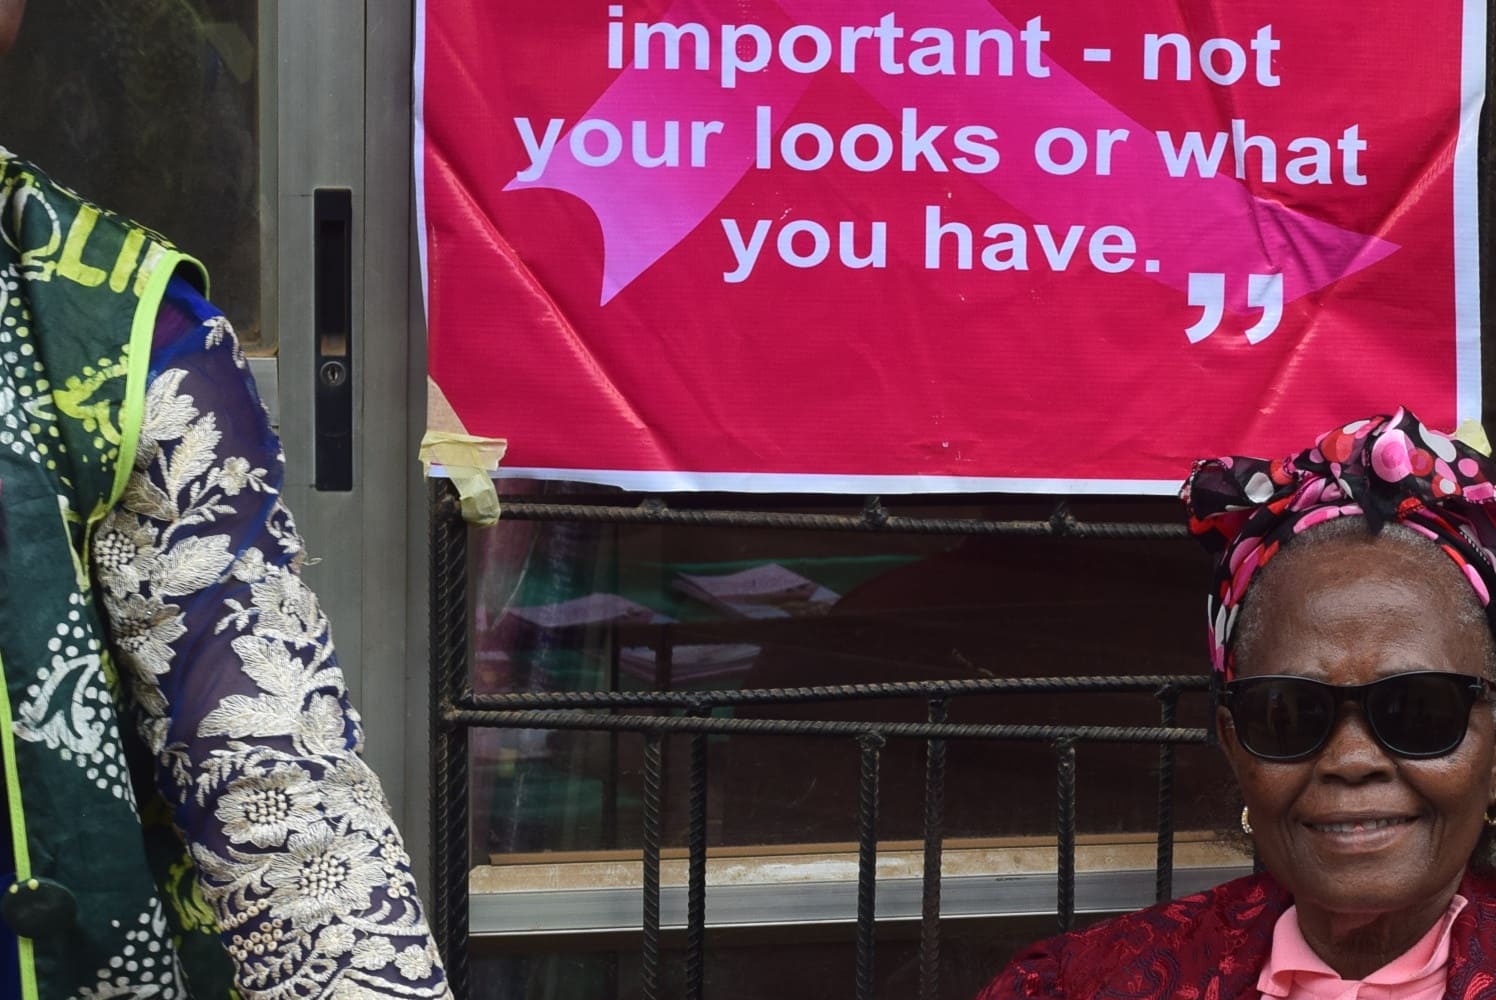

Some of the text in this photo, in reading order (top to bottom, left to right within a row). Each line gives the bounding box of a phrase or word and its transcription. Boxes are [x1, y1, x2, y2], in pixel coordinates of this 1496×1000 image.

[607, 6, 1050, 89] important
[1143, 25, 1281, 87] not
[514, 106, 1367, 186] your looks or what
[721, 205, 1160, 283] you have.
